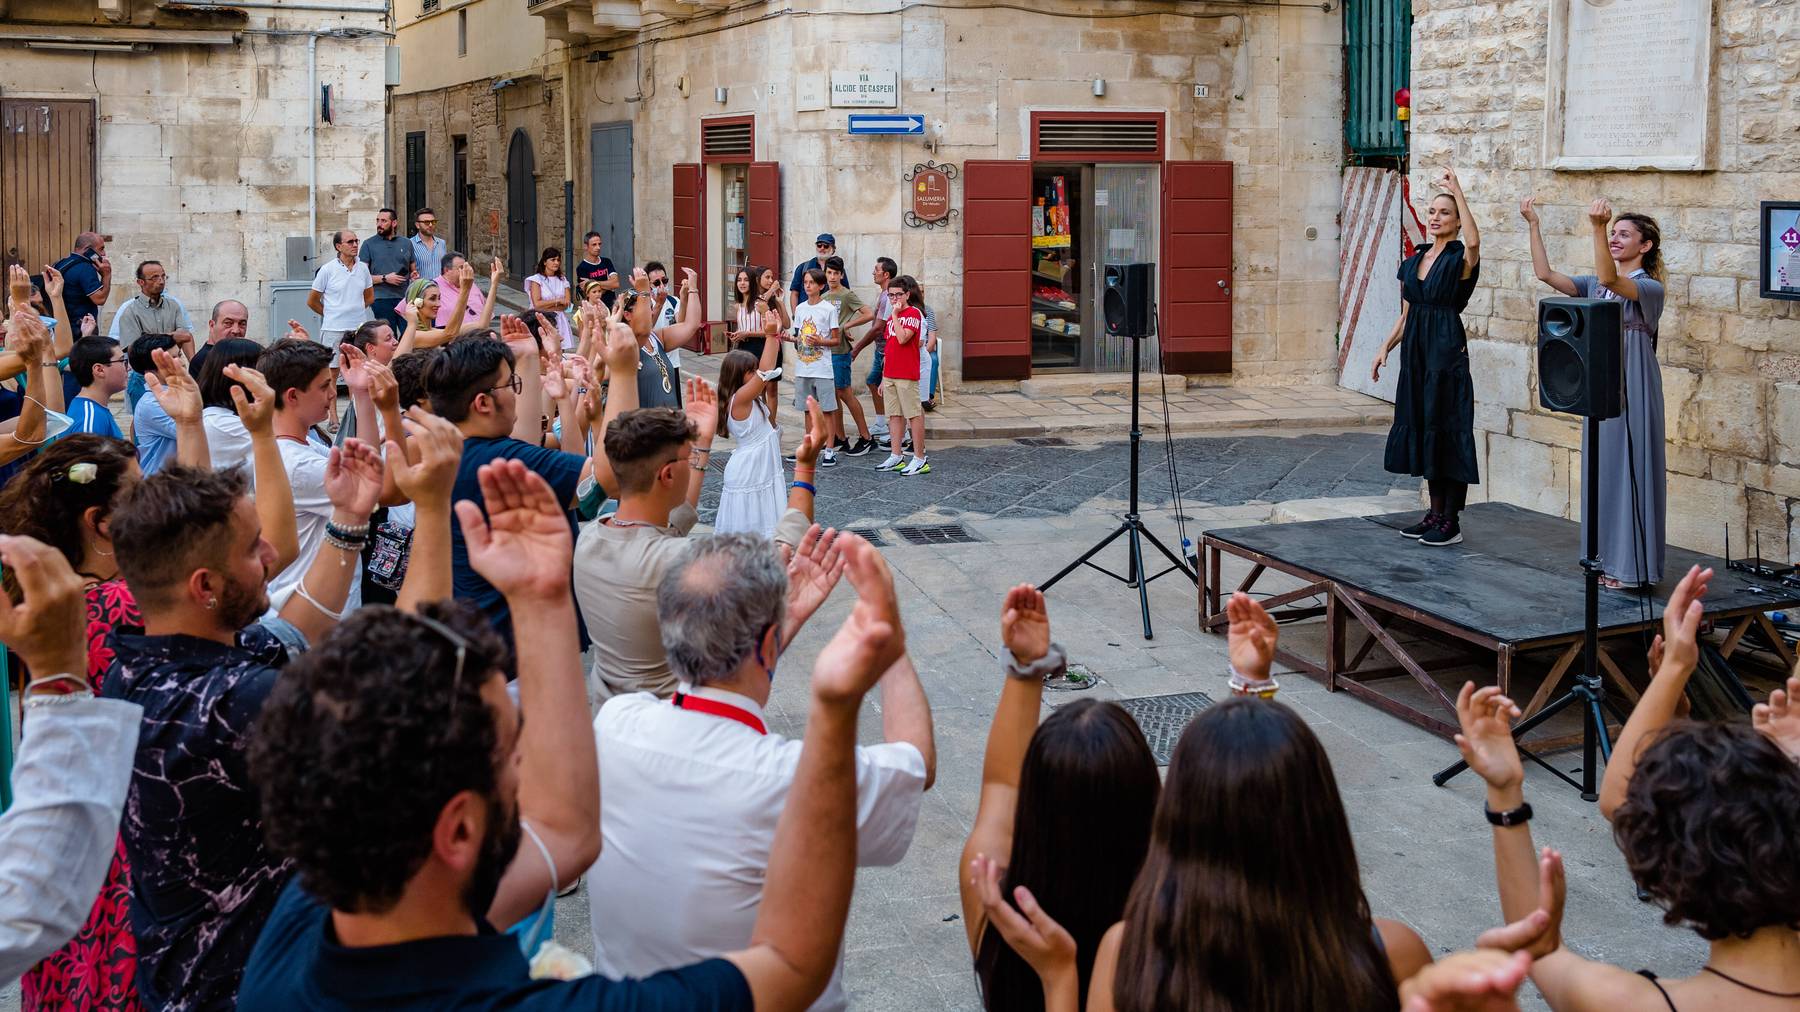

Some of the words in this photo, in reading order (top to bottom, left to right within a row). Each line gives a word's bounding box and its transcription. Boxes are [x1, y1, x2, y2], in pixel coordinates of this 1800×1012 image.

[835, 84, 856, 93] ALCIDE
[860, 84, 867, 93] DE
[868, 84, 894, 93] GASPERI
[1784, 232, 1799, 243] 11
